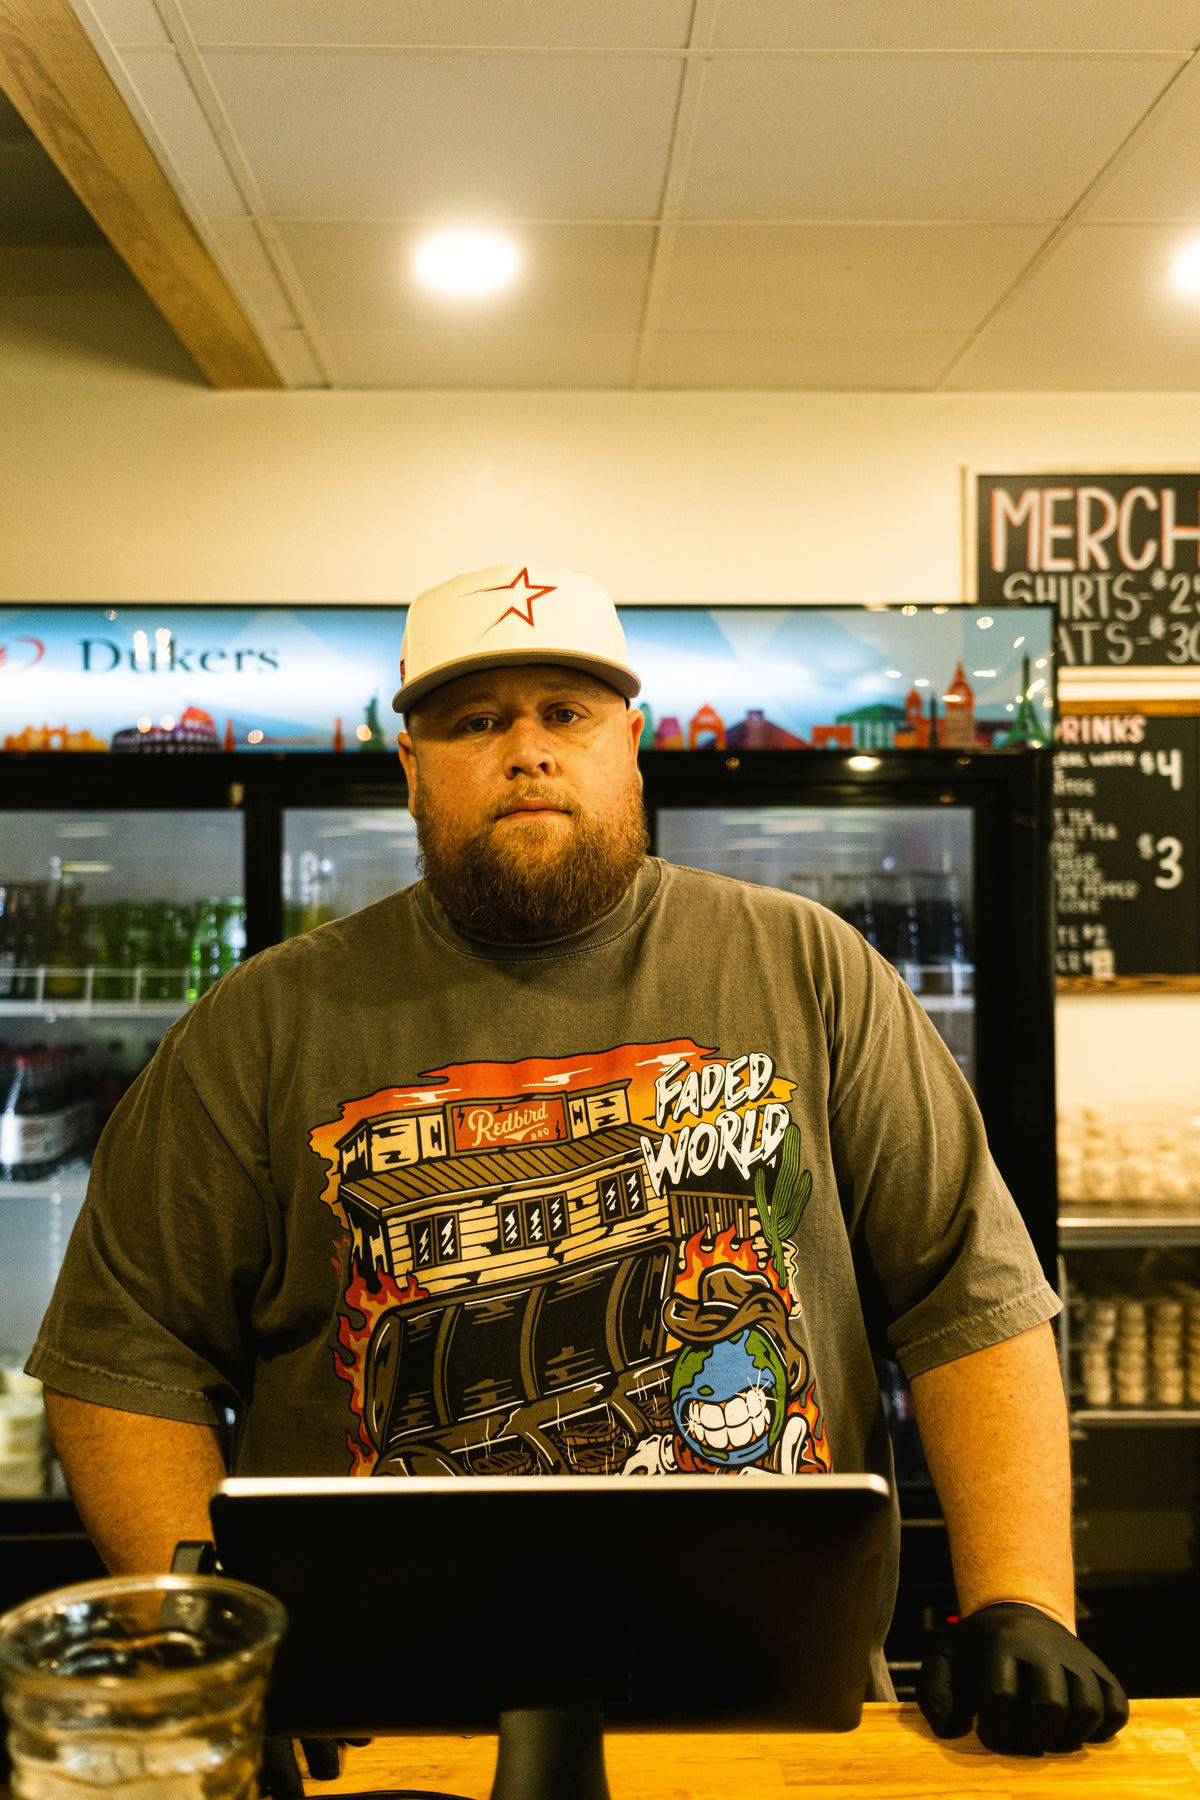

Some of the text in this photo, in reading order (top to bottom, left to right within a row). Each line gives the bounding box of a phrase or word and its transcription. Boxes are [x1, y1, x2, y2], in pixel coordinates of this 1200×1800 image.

[990, 486, 1200, 573] MERCH
[79, 637, 280, 674] Dukers
[1140, 748, 1182, 791] $4
[1137, 833, 1183, 890] $3
[654, 1052, 776, 1128] FADED
[467, 1100, 549, 1147] Redbird
[530, 1127, 550, 1141] BBQ
[639, 1103, 790, 1198] WORLD
